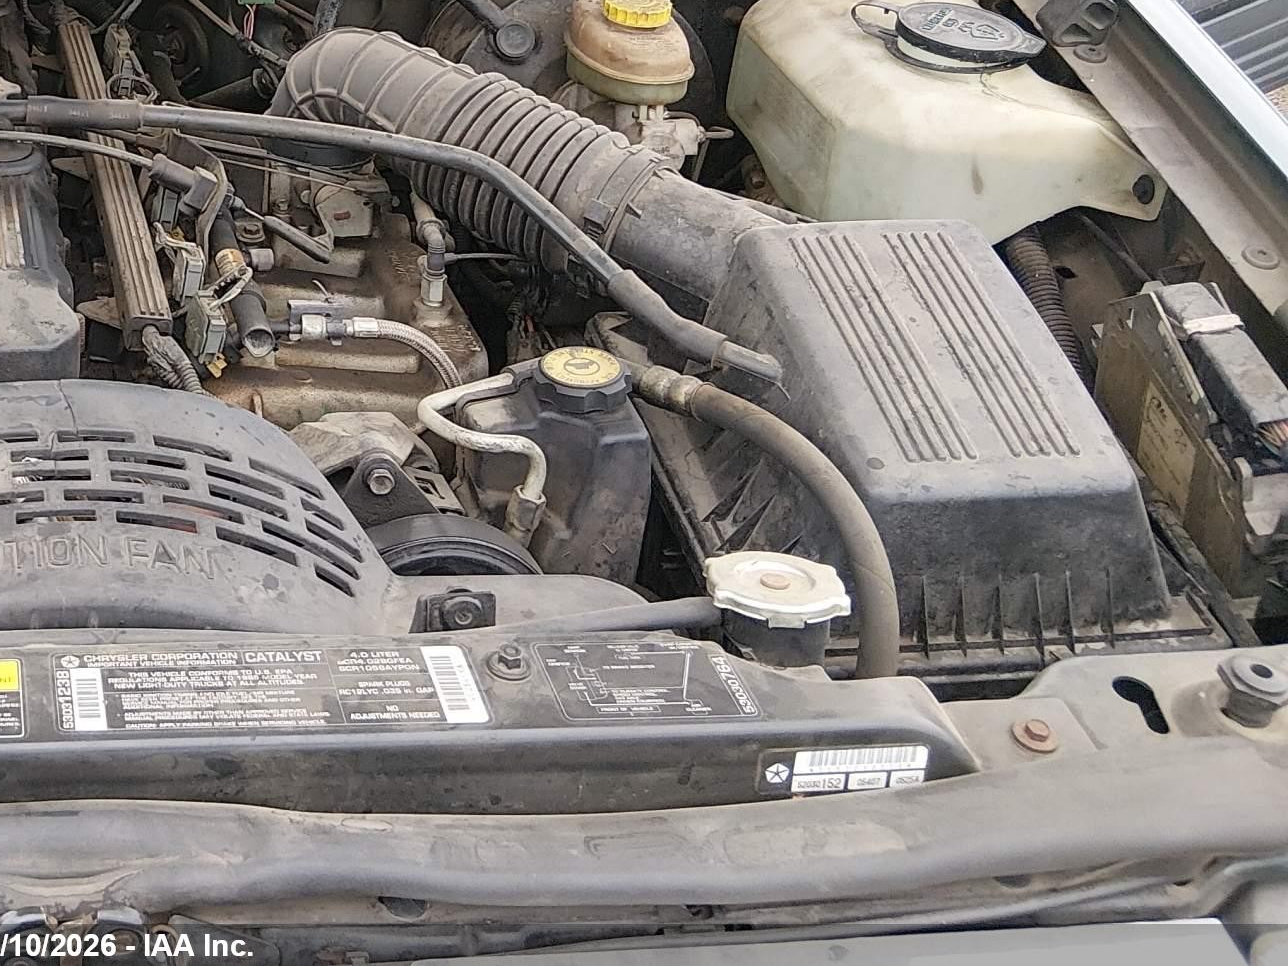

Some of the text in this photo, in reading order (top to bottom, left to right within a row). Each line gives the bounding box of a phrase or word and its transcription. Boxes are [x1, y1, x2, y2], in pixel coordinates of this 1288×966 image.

[126, 535, 215, 580] FAN
[84, 650, 322, 664] CHRYSLER CORPORATION CATALYST
[189, 669, 238, 677] CONFORMS
[295, 672, 318, 680] YEAR
[711, 656, 755, 713] 53030764
[339, 687, 379, 695] RC12LYC
[416, 686, 435, 694] GAP
[56, 670, 74, 730] 53031238
[350, 712, 408, 720] ADJUSTMENTS
